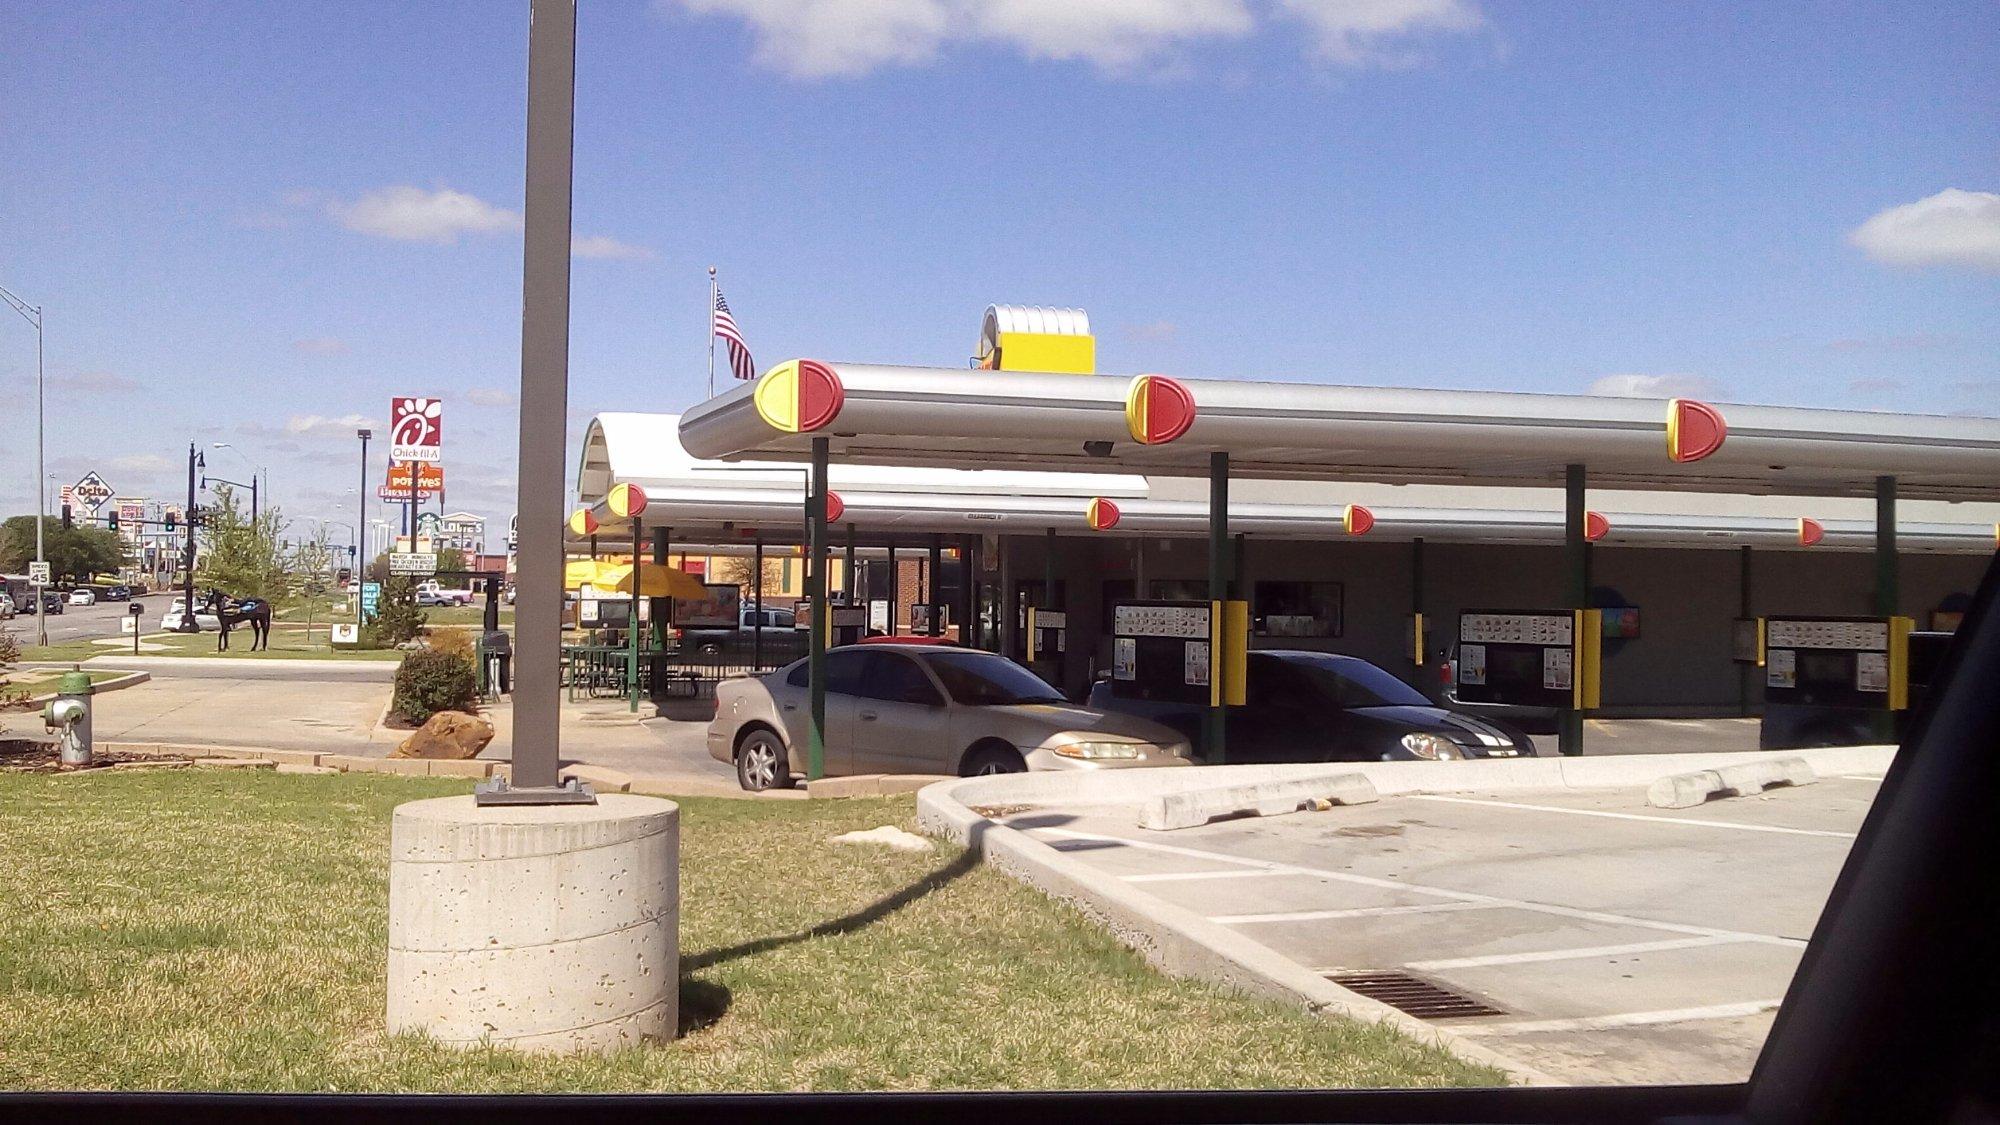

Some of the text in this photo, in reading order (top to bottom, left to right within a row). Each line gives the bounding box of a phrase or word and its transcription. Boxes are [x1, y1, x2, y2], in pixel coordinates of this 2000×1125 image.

[392, 447, 438, 459] Chick-fil-A
[78, 486, 109, 496] Delta
[31, 573, 48, 583] 45
